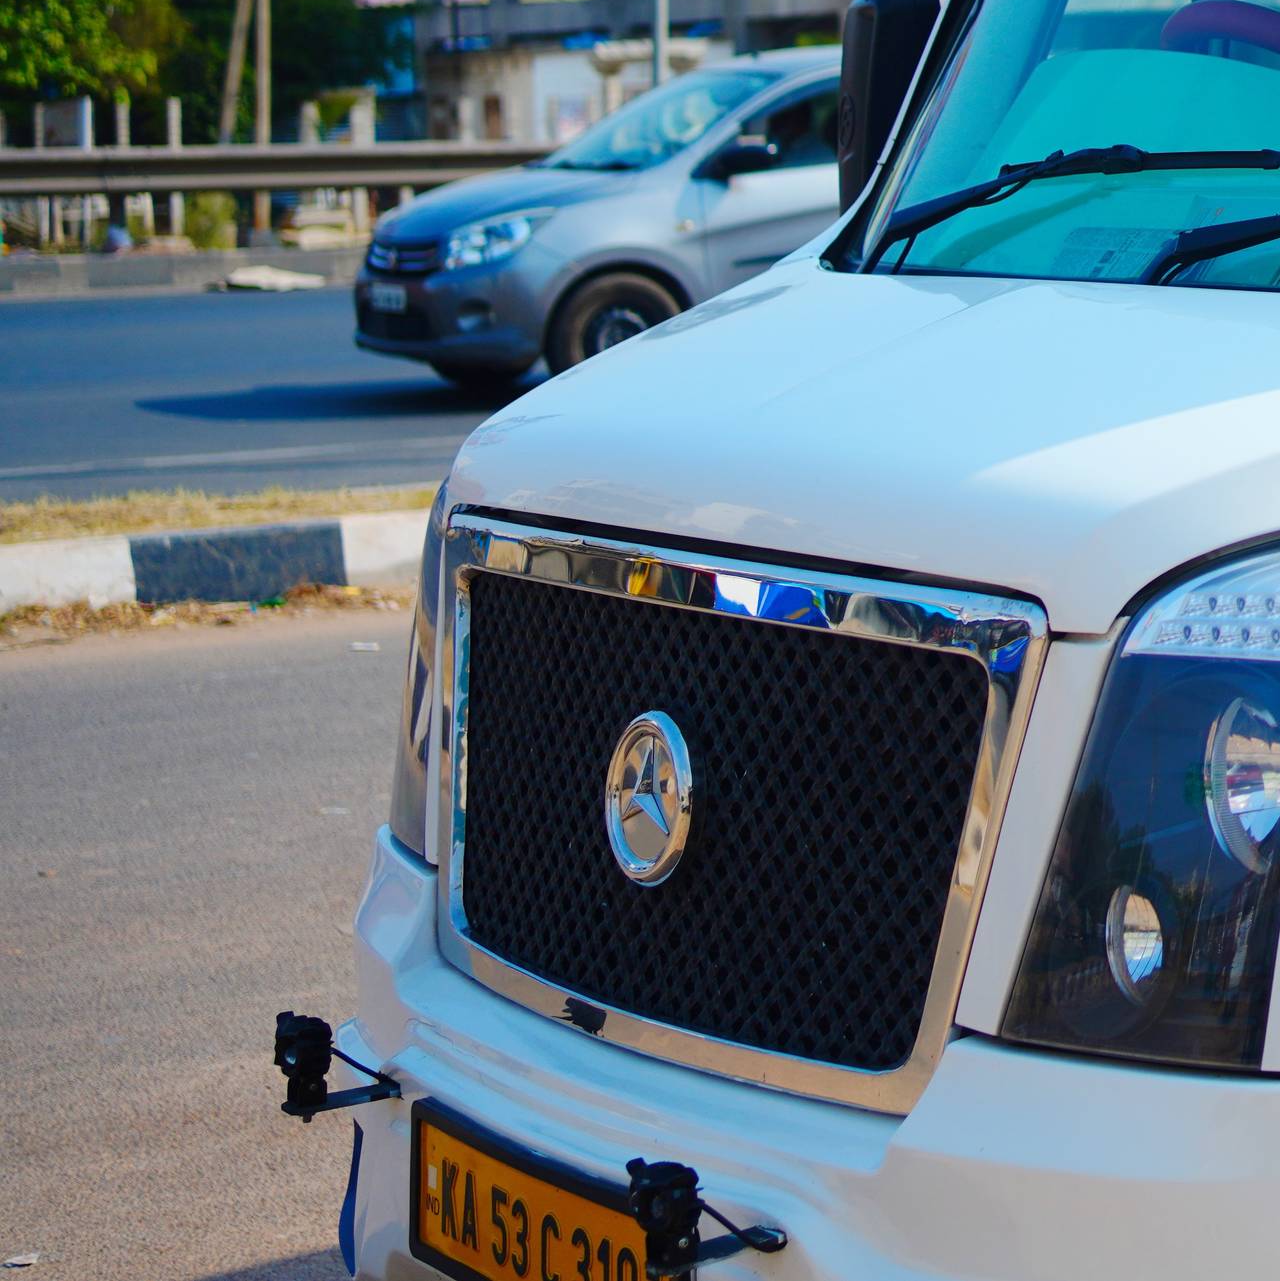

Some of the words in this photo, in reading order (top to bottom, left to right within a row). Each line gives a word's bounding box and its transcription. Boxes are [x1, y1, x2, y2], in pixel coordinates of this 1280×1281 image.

[426, 1193, 440, 1216] IND
[441, 1156, 480, 1253] KA
[490, 1185, 530, 1278] 53
[541, 1214, 562, 1281] C
[571, 1227, 639, 1281] 310
